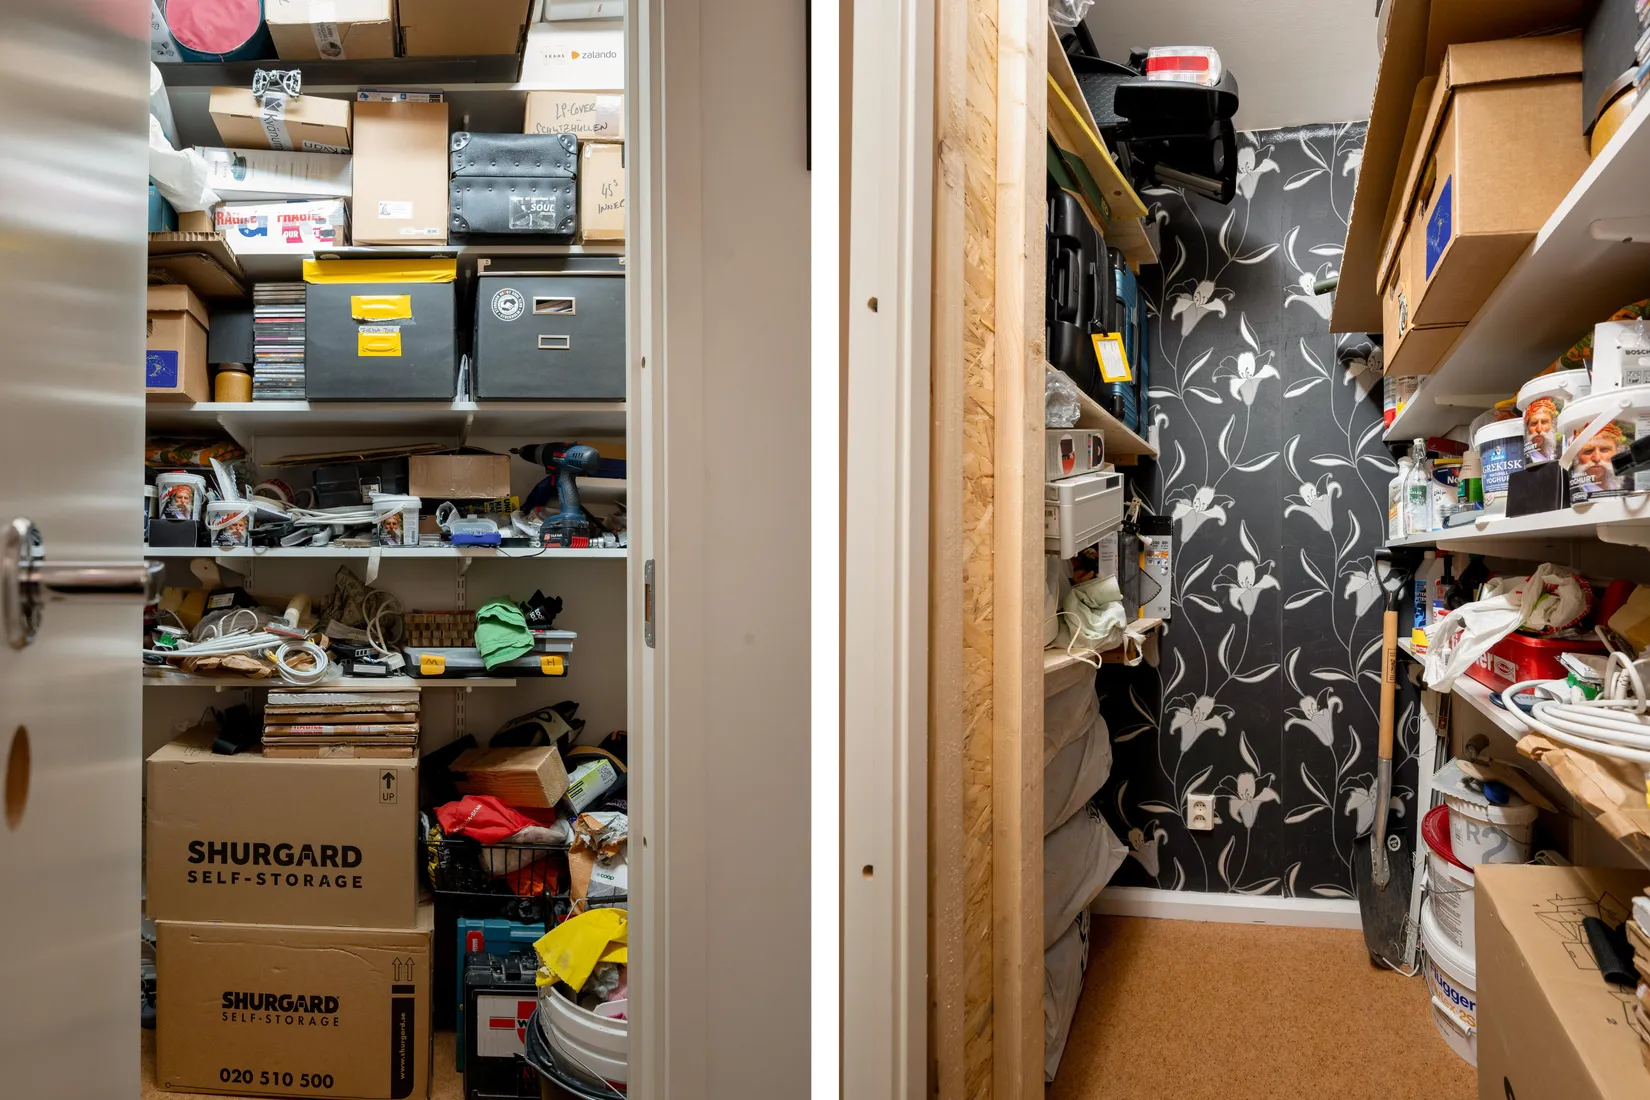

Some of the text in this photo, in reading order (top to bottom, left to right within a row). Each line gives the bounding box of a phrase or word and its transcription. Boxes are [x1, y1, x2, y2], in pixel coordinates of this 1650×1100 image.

[582, 50, 617, 59] zalando
[556, 103, 597, 120] LP-COVER
[1486, 475, 1510, 484] YOGHUR
[382, 793, 395, 801] UP
[187, 840, 363, 868] SHURGARD
[187, 870, 363, 888] SELF-STORAGE
[221, 991, 340, 1014] SHURGARD
[219, 1068, 334, 1089] 020 510 500
